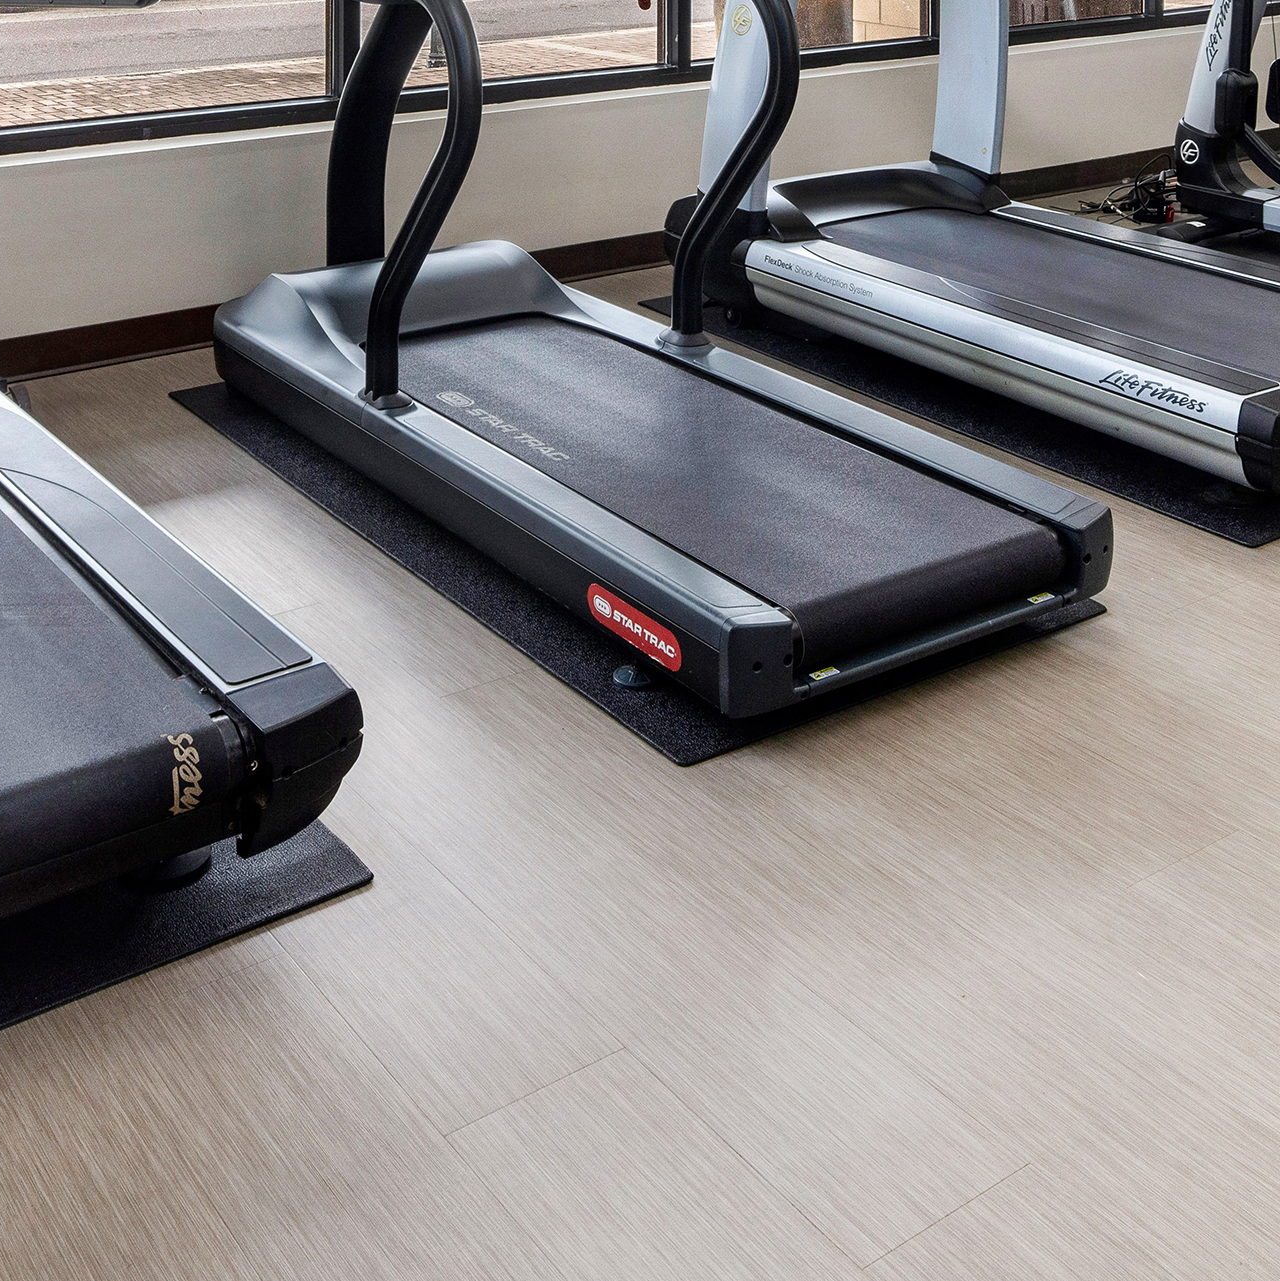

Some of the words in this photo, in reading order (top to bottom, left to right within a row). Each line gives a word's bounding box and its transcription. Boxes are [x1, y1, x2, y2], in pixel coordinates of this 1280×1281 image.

[764, 255, 793, 272] FlexDeck
[794, 264, 814, 278] Shock
[814, 271, 848, 290] Absorption
[848, 282, 873, 298] System
[1099, 369, 1140, 392] Life
[1135, 379, 1207, 413] Fitness
[465, 408, 519, 433] STAR
[513, 432, 570, 461] TRAC
[613, 609, 642, 637] STAR
[643, 628, 675, 658] TRAC
